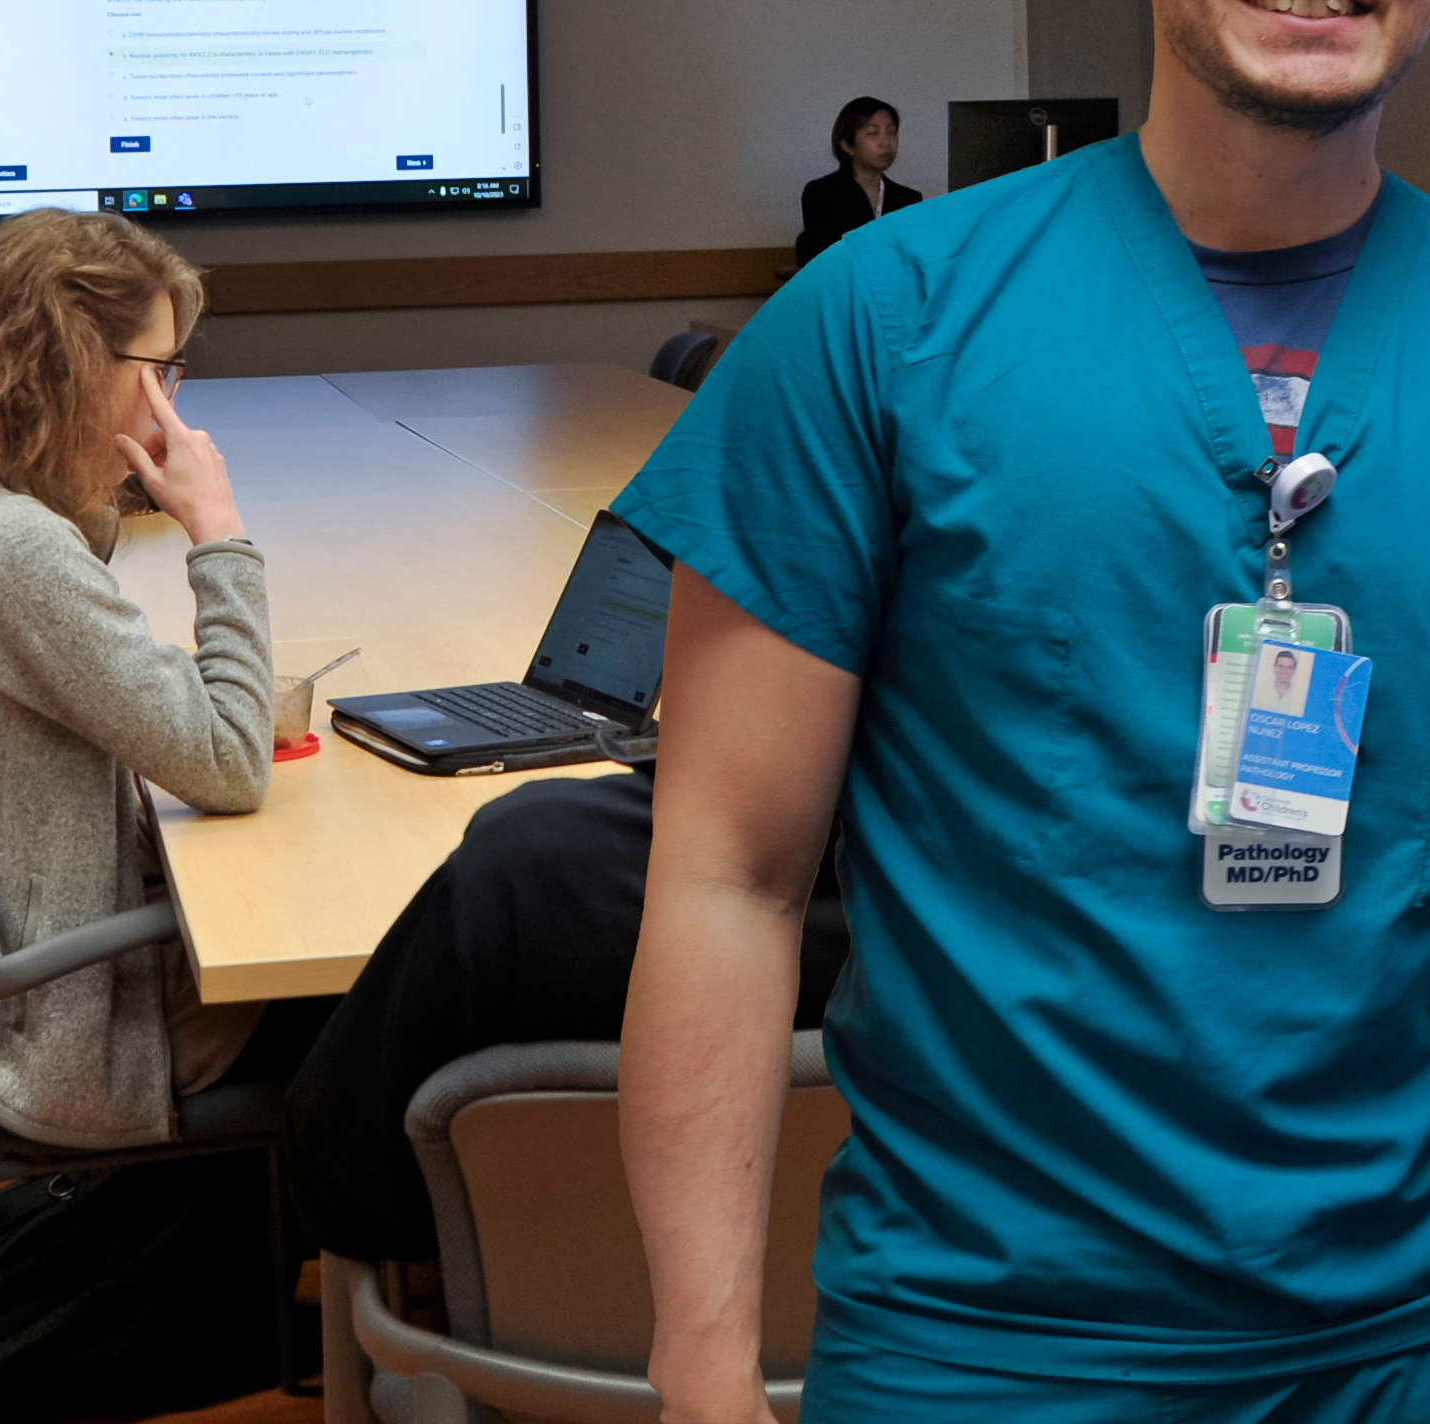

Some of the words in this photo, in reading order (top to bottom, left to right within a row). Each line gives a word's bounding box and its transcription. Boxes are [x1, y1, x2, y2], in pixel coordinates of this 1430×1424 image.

[1247, 725, 1284, 739] NUNEZ
[1250, 713, 1287, 727] OSCAR
[1287, 719, 1321, 734] LOPEZ
[1240, 764, 1296, 781] PATHOLOGY
[1242, 753, 1290, 768] ASSISTANT
[1290, 762, 1343, 778] PROFESSOR
[1217, 843, 1331, 864] Pathology
[1226, 866, 1320, 884] MD/PhD
